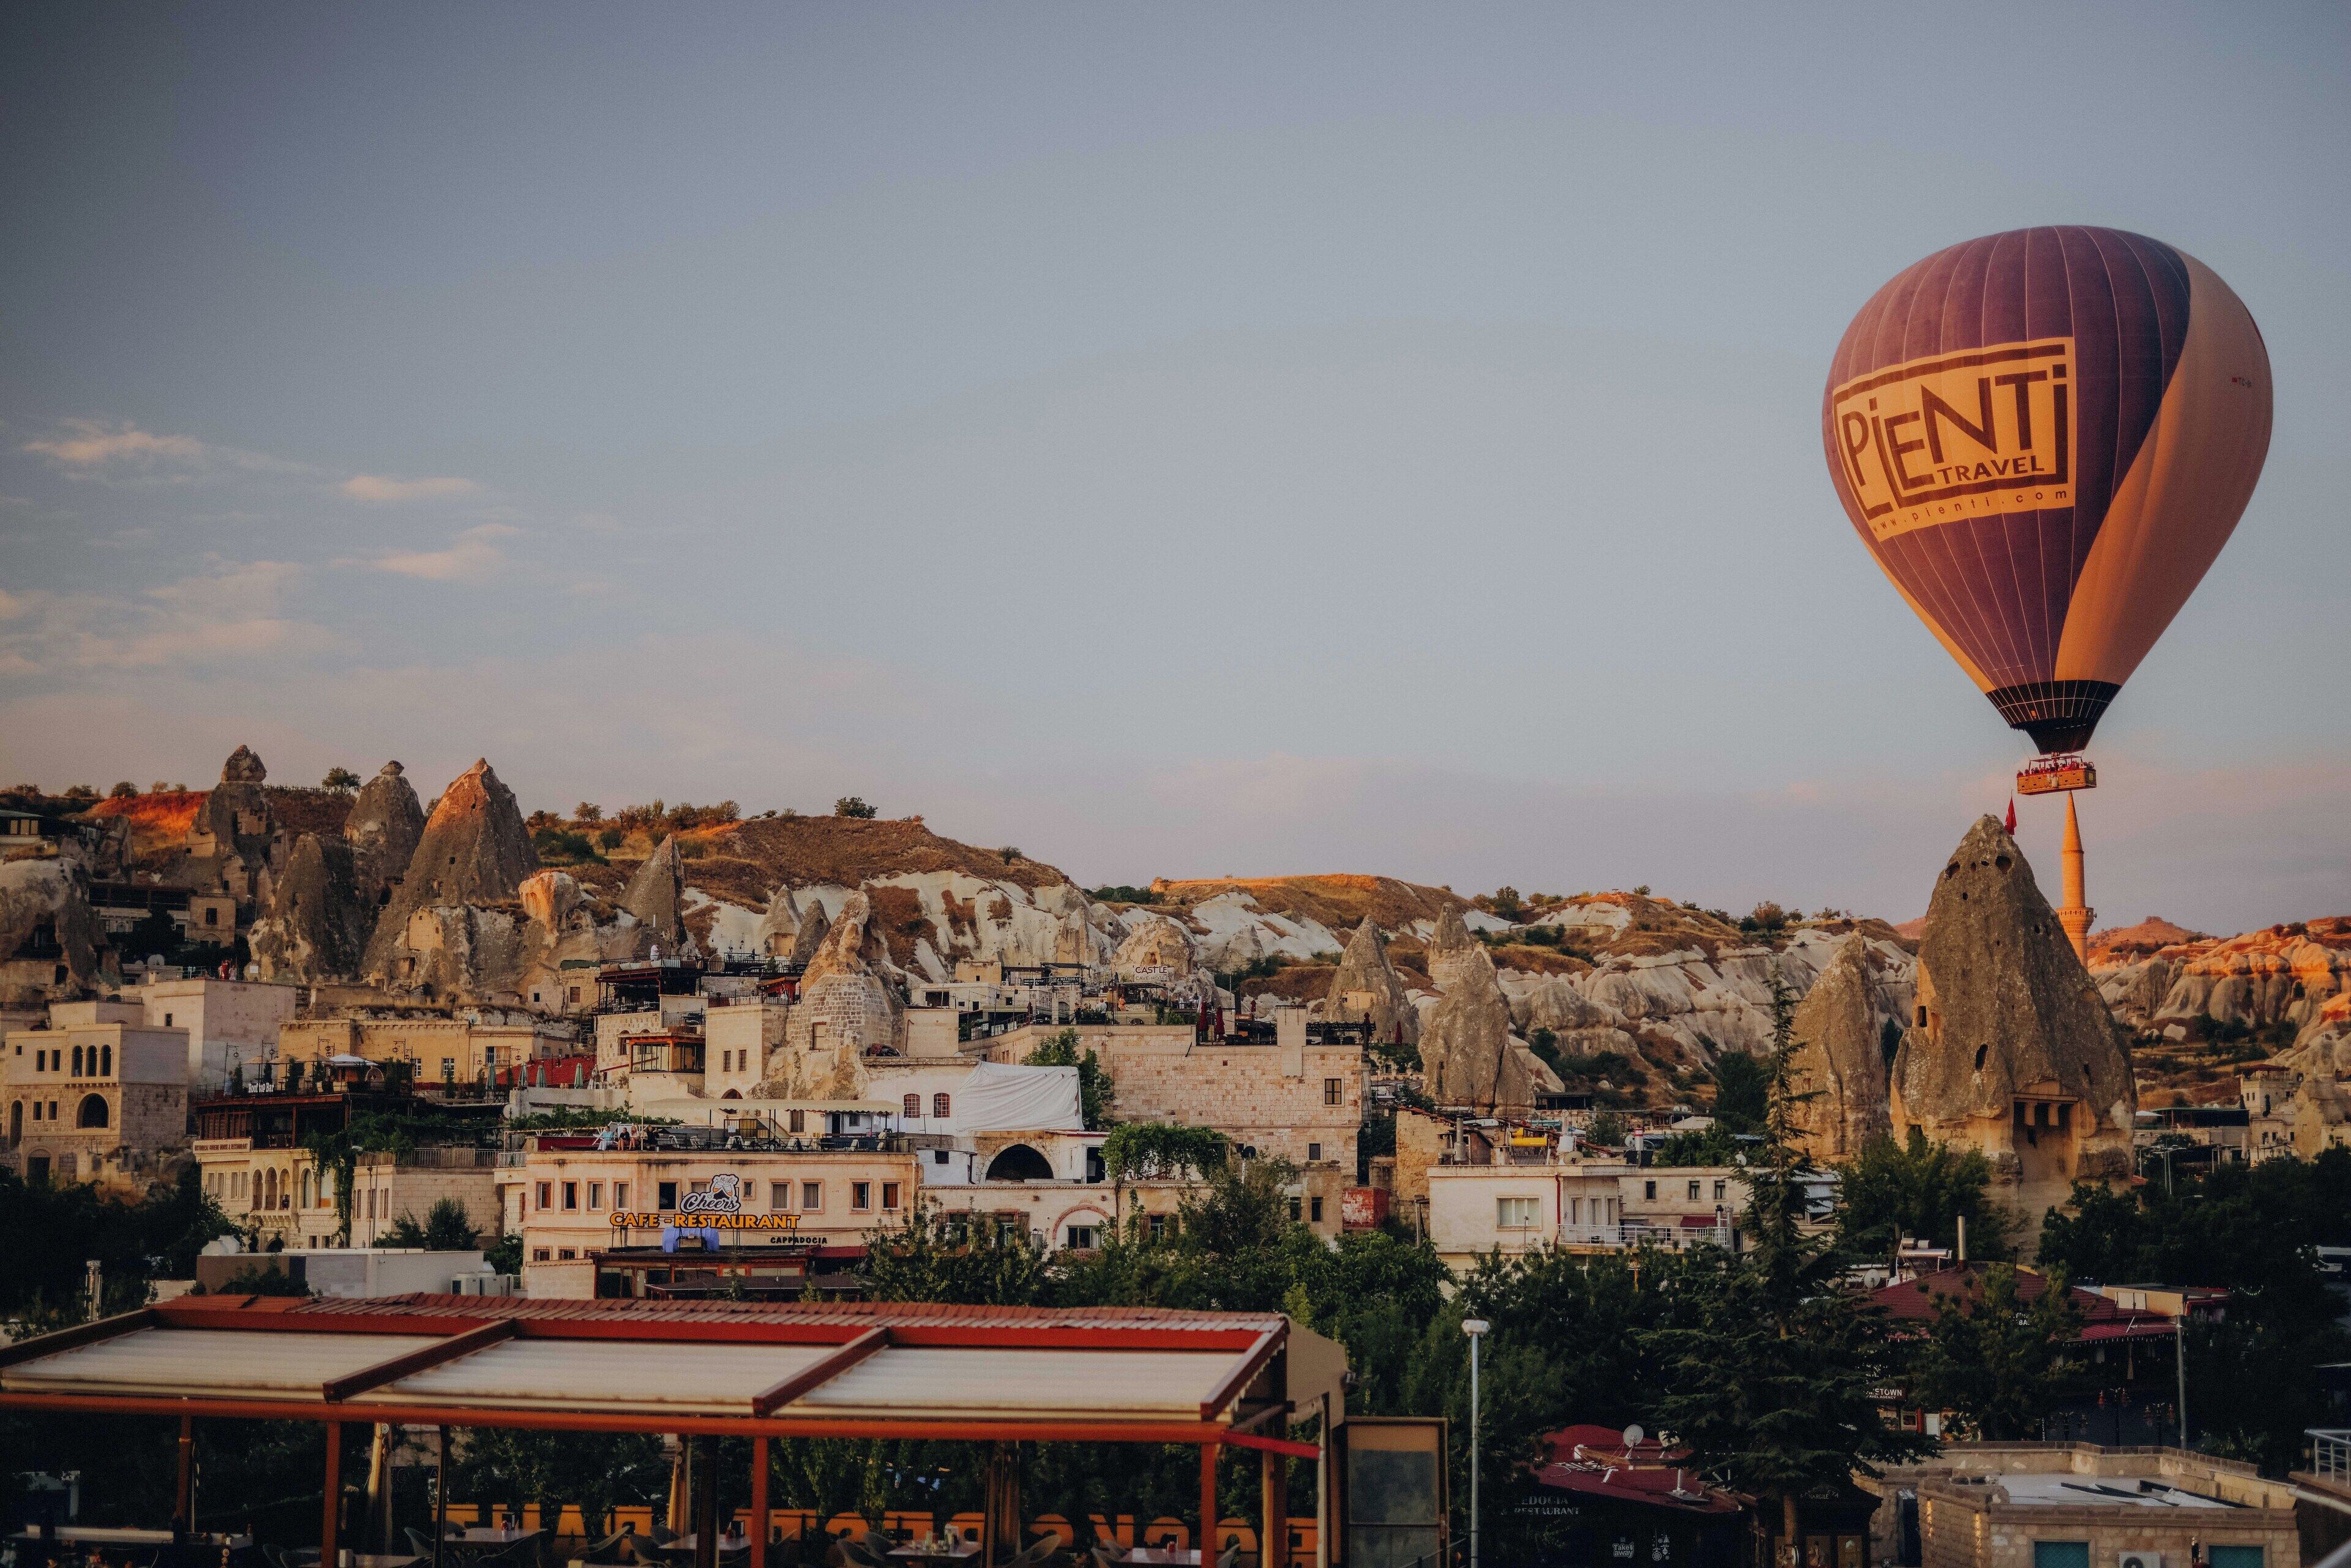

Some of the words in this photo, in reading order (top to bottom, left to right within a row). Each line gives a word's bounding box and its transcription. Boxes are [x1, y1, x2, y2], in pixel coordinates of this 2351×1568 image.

[1937, 455, 2045, 484] TRAVEL
[249, 1083, 258, 1093] Roof
[266, 1082, 275, 1092] Bar
[681, 1191, 739, 1212] Cheers
[610, 1212, 659, 1228] CAFE
[674, 1214, 801, 1229] RESTAURANT
